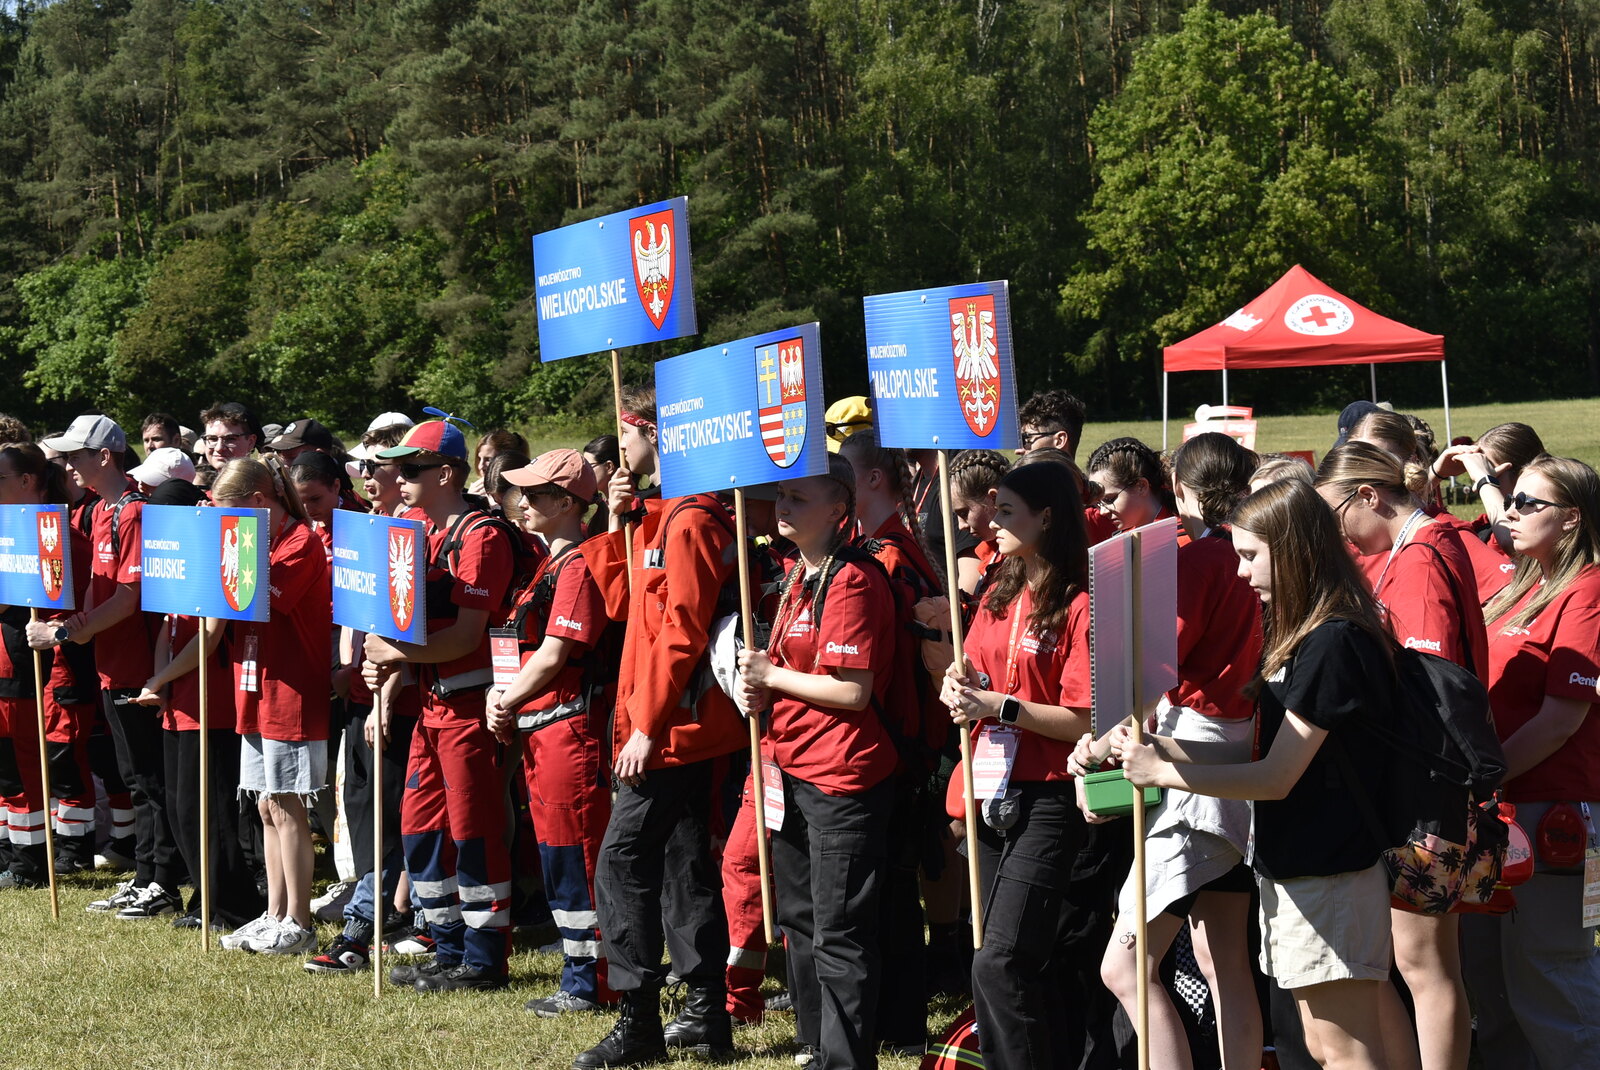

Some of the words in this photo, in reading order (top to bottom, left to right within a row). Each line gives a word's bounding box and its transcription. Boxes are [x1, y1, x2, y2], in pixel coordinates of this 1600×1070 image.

[538, 266, 582, 287] WOJEWÓDZTWO
[540, 278, 627, 321] WIELKOPOLSKIE
[869, 342, 908, 359] WOJEWÓDZTWO
[872, 367, 939, 399] MAŁOPOLSKIE
[660, 396, 704, 418] WOJEWÓDZTWO
[661, 410, 754, 458] ŚWIĘTOKRZYSKIE
[144, 556, 186, 580] LUBUSKIE
[334, 565, 377, 596] MAZOWIECKIE
[464, 584, 490, 598] Pentel
[555, 615, 583, 631] Pentel
[825, 641, 860, 656] Pentel
[1404, 636, 1442, 651] Pentel
